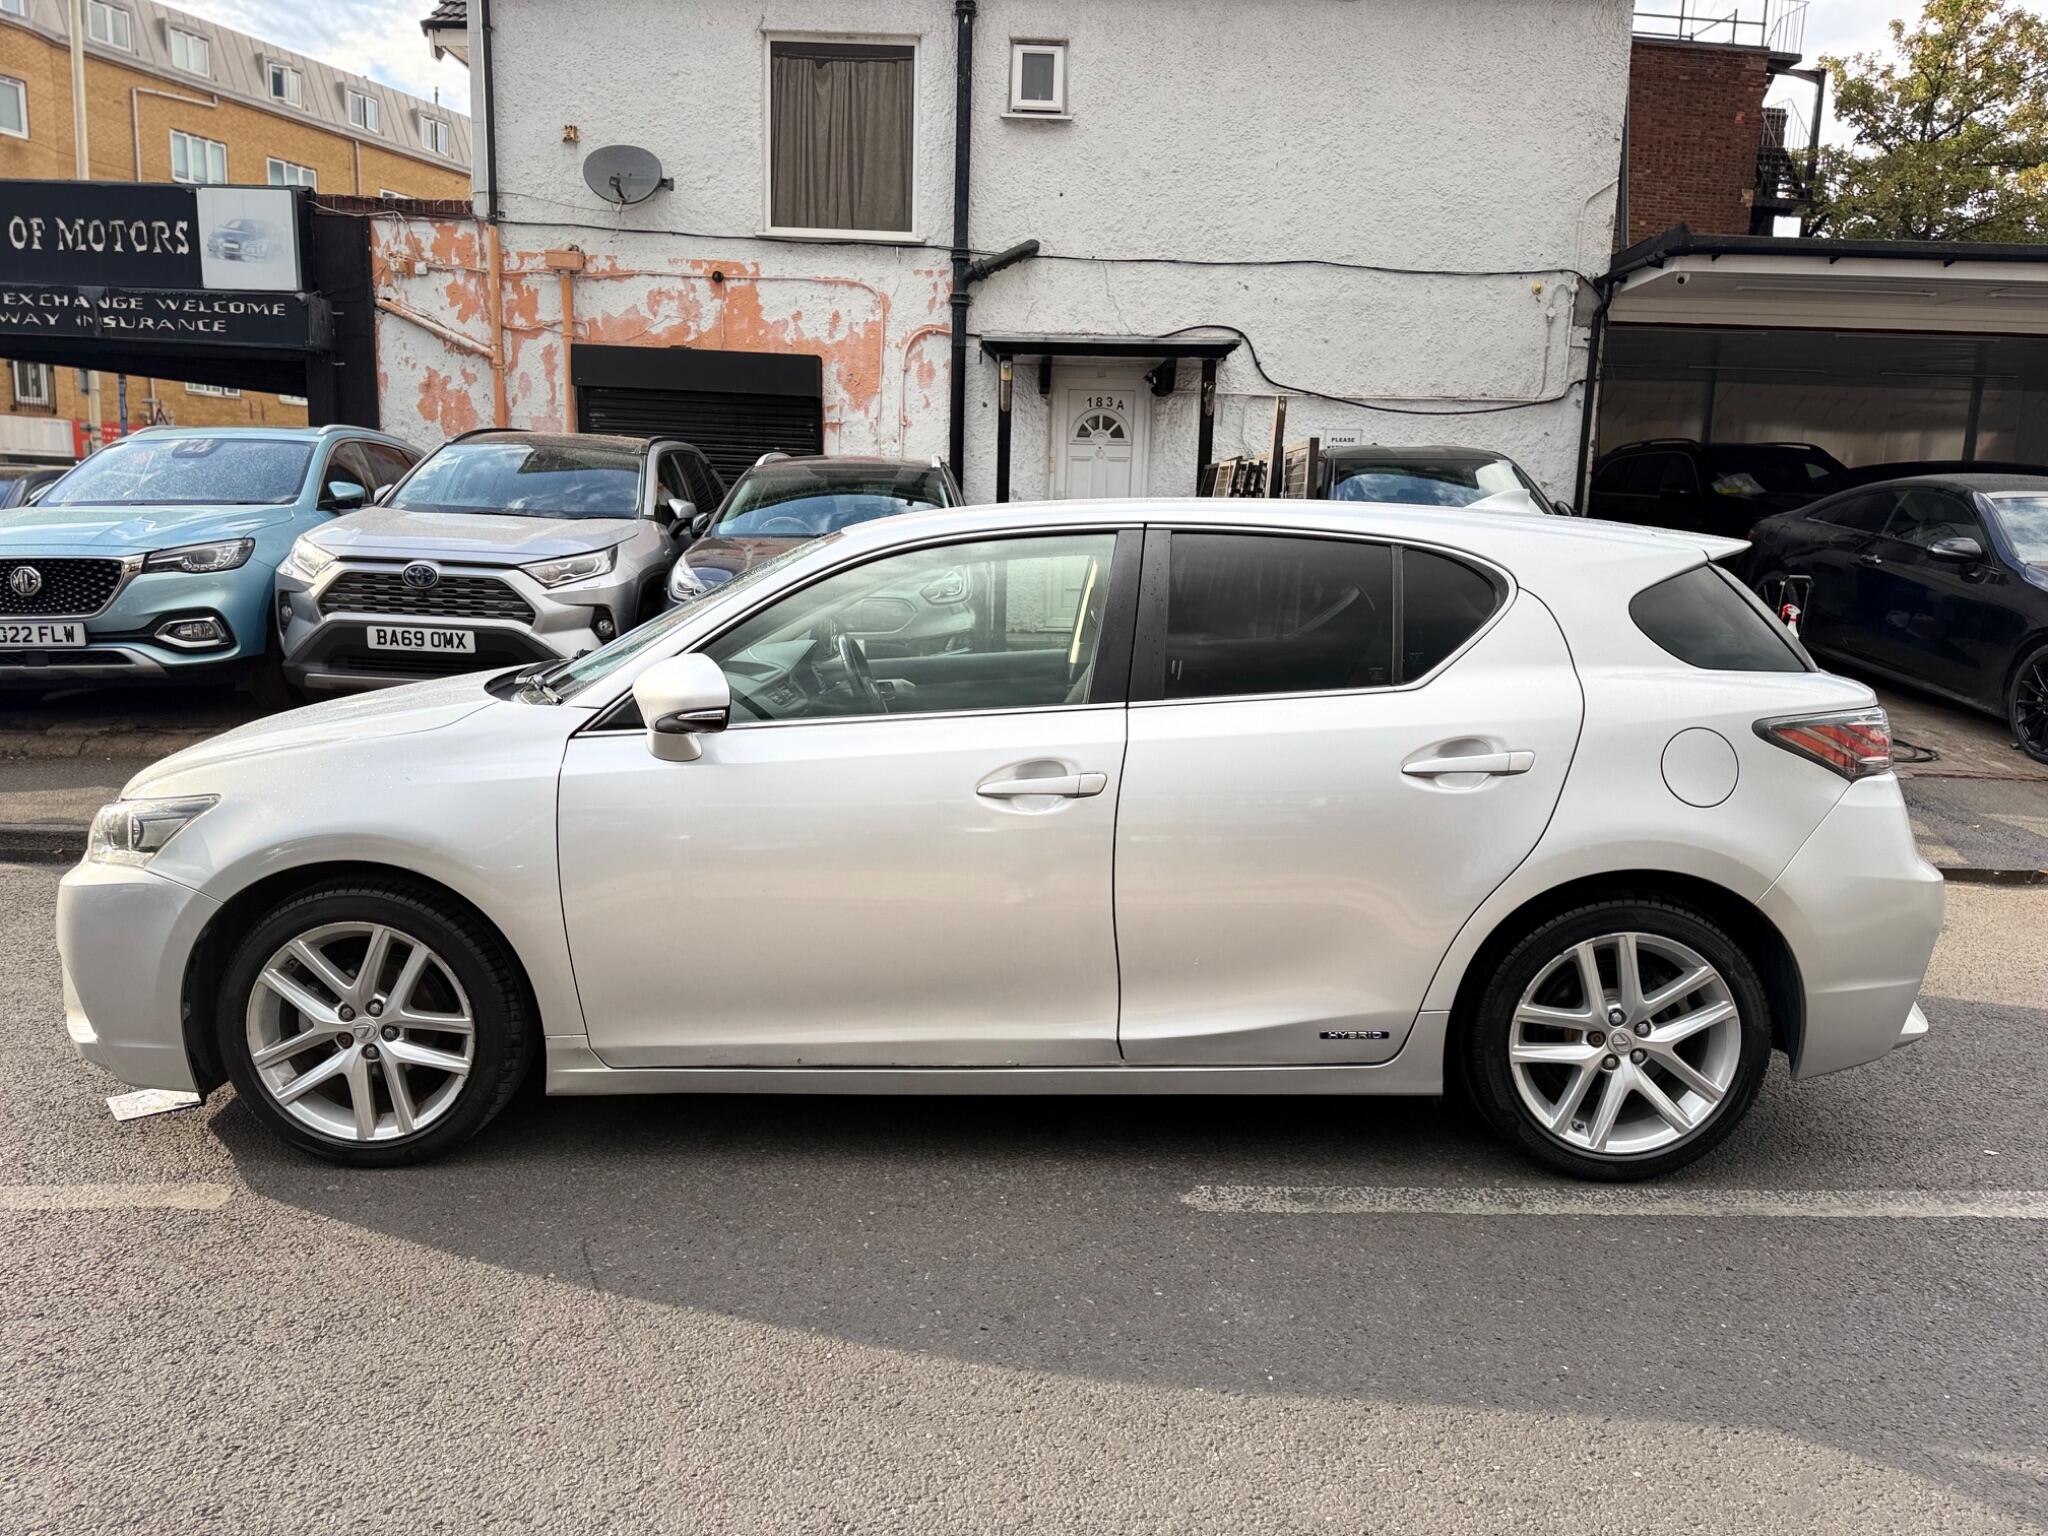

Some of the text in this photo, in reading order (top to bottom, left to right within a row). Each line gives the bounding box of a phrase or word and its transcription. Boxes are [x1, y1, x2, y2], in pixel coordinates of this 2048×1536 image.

[9, 215, 190, 255] OF MOTORS
[3, 292, 286, 316] EXCHANGE WELCOME
[75, 314, 227, 333] INSURANCE
[1087, 396, 1124, 410] 183A
[13, 569, 37, 592] MG
[38, 626, 75, 643] FLW
[376, 629, 467, 649] BA69 OMX
[1328, 1030, 1382, 1039] HYBRID
